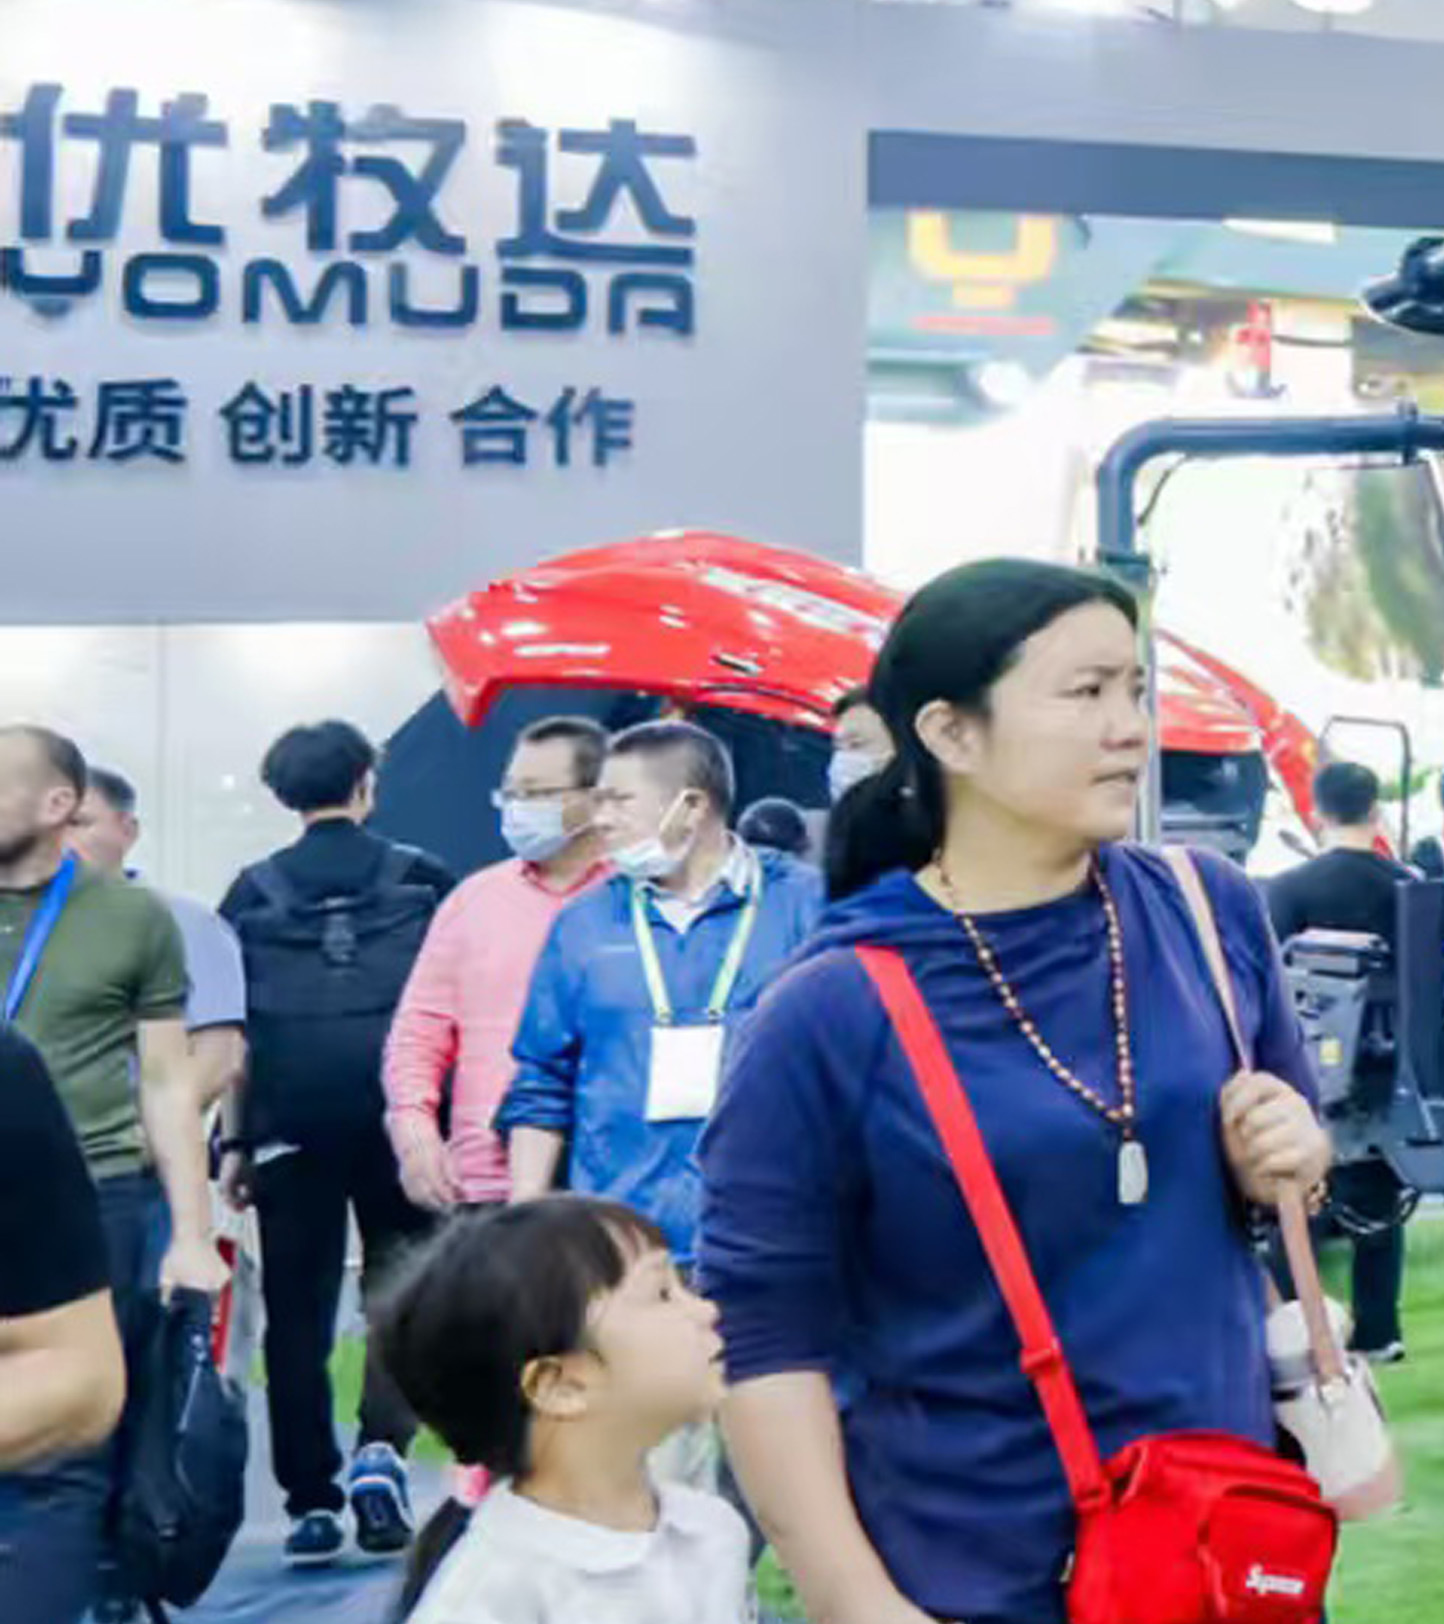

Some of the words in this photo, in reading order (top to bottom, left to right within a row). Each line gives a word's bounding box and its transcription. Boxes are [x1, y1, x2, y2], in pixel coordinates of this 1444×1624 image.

[0, 83, 696, 264] 优牧达
[218, 381, 419, 469] 创新
[448, 385, 635, 469] 合作
